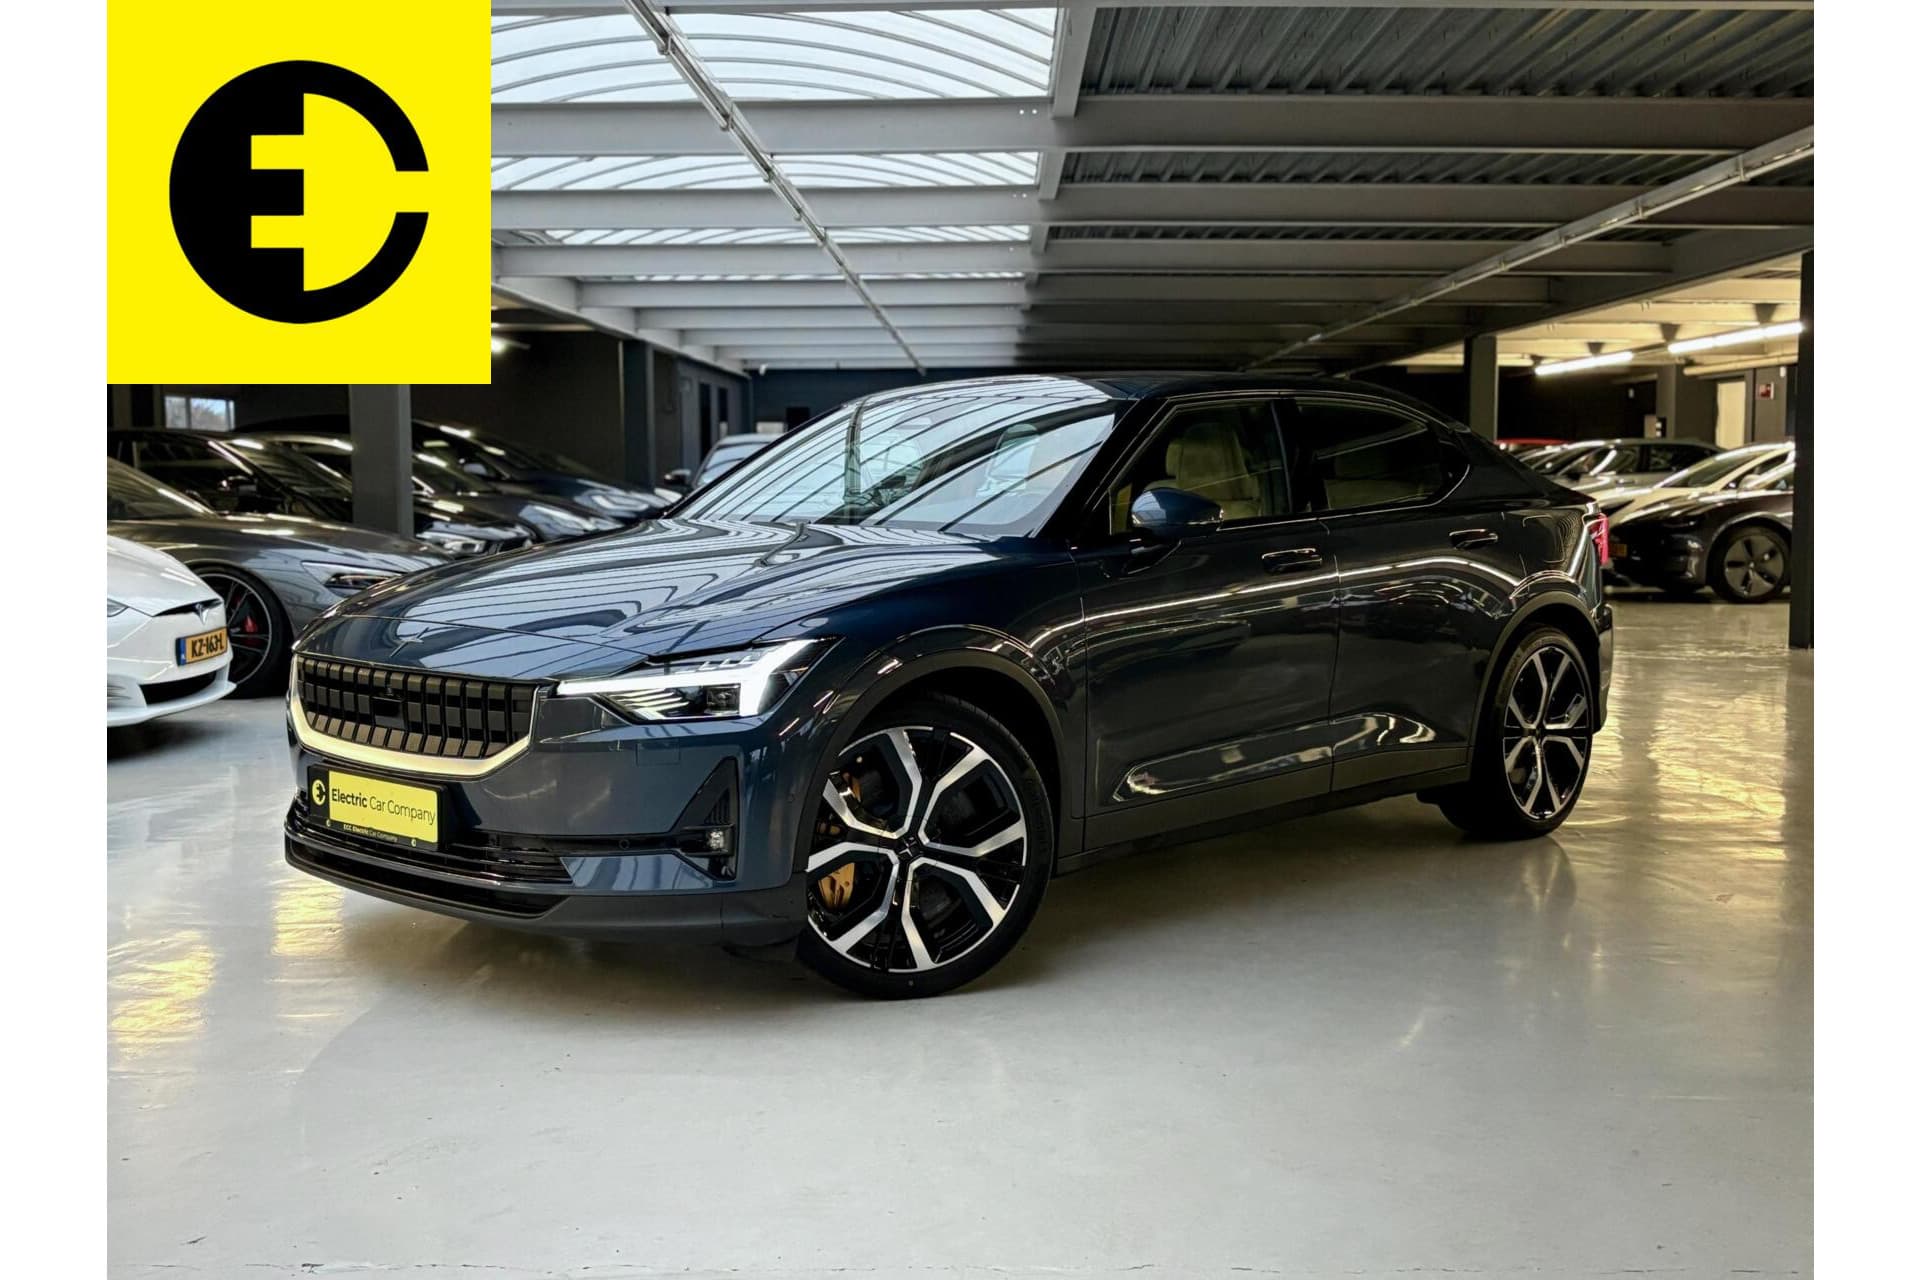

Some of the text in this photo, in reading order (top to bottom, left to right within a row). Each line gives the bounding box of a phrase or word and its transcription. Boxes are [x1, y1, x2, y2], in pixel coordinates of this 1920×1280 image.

[331, 788, 435, 825] Electric Car Company
